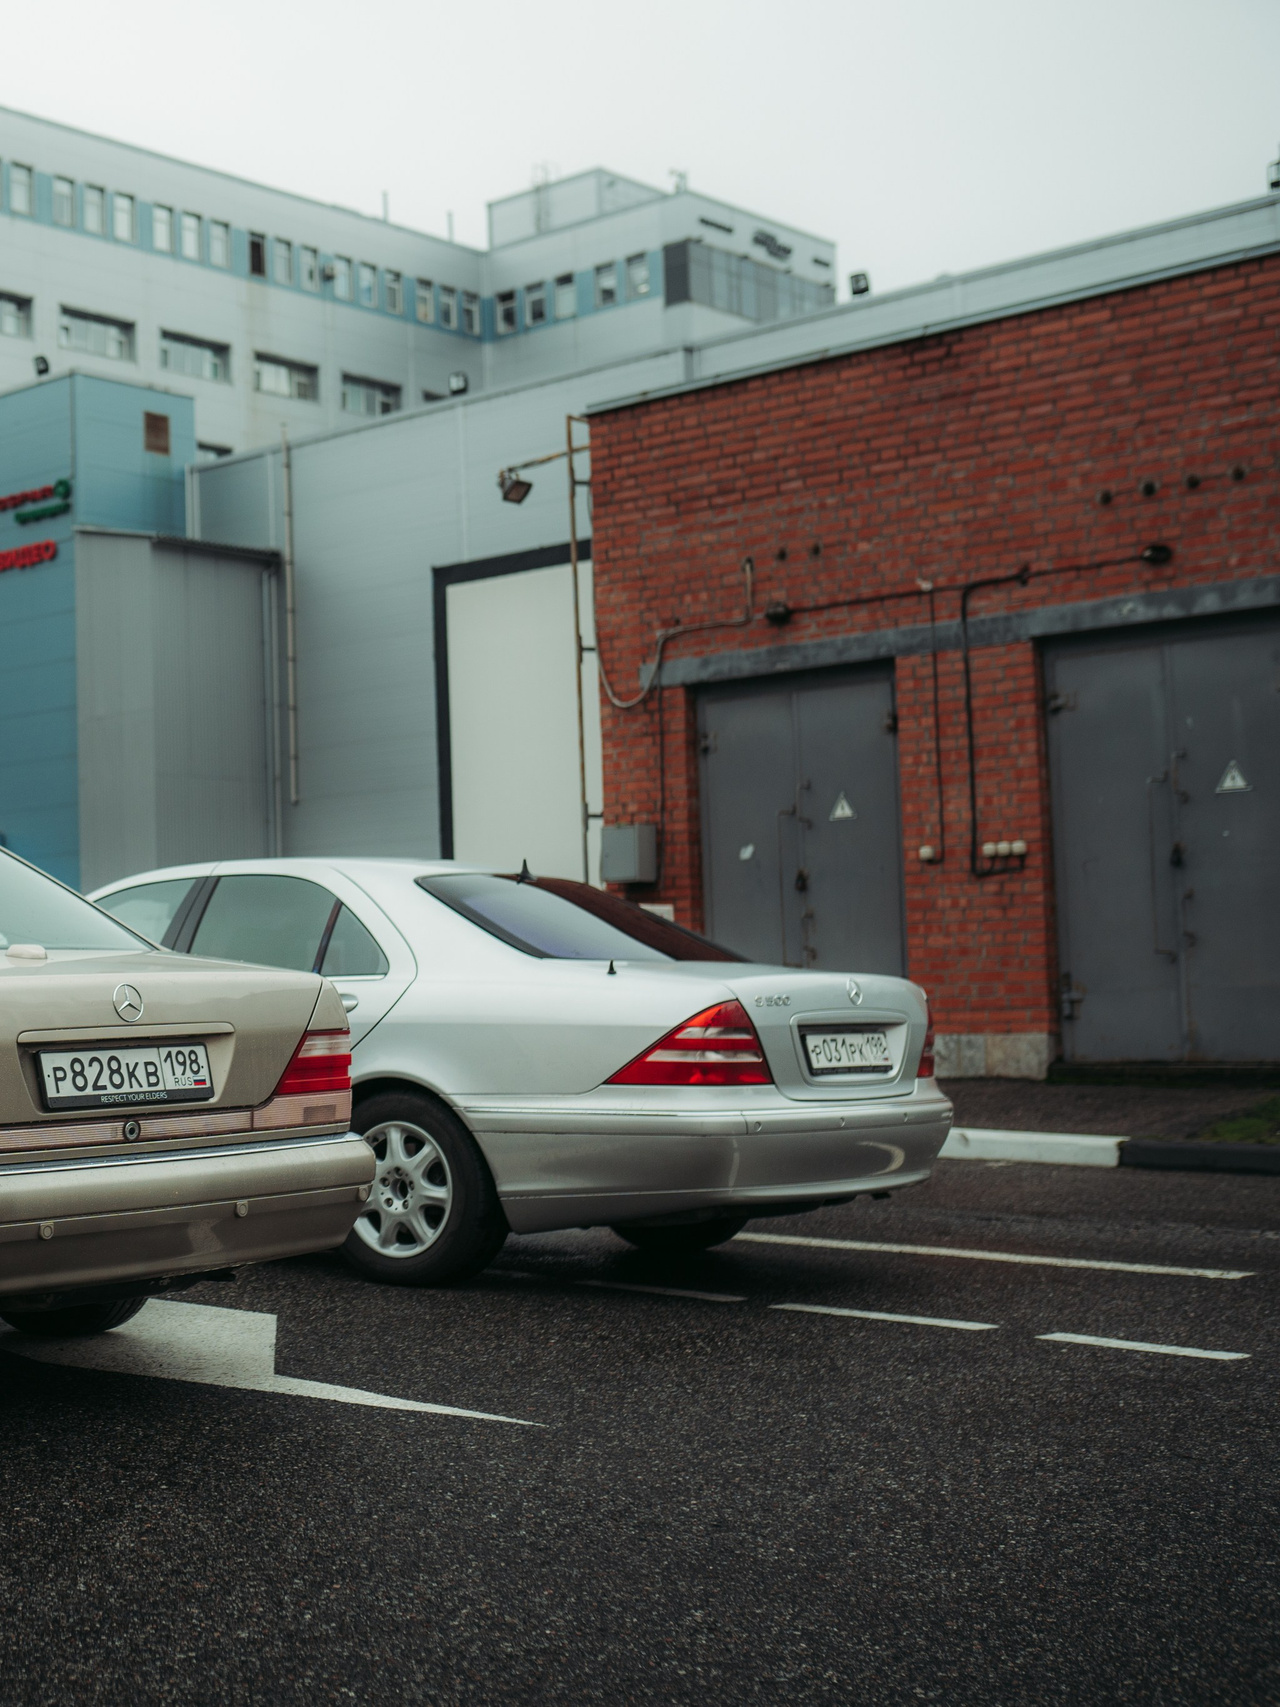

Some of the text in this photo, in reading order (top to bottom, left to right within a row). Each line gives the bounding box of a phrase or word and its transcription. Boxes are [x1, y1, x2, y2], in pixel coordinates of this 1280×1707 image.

[754, 995, 764, 1007] S
[163, 1049, 202, 1076] 198
[174, 1076, 193, 1086] RUS
[100, 1091, 168, 1103] RESPECT YOUR ELDERS
